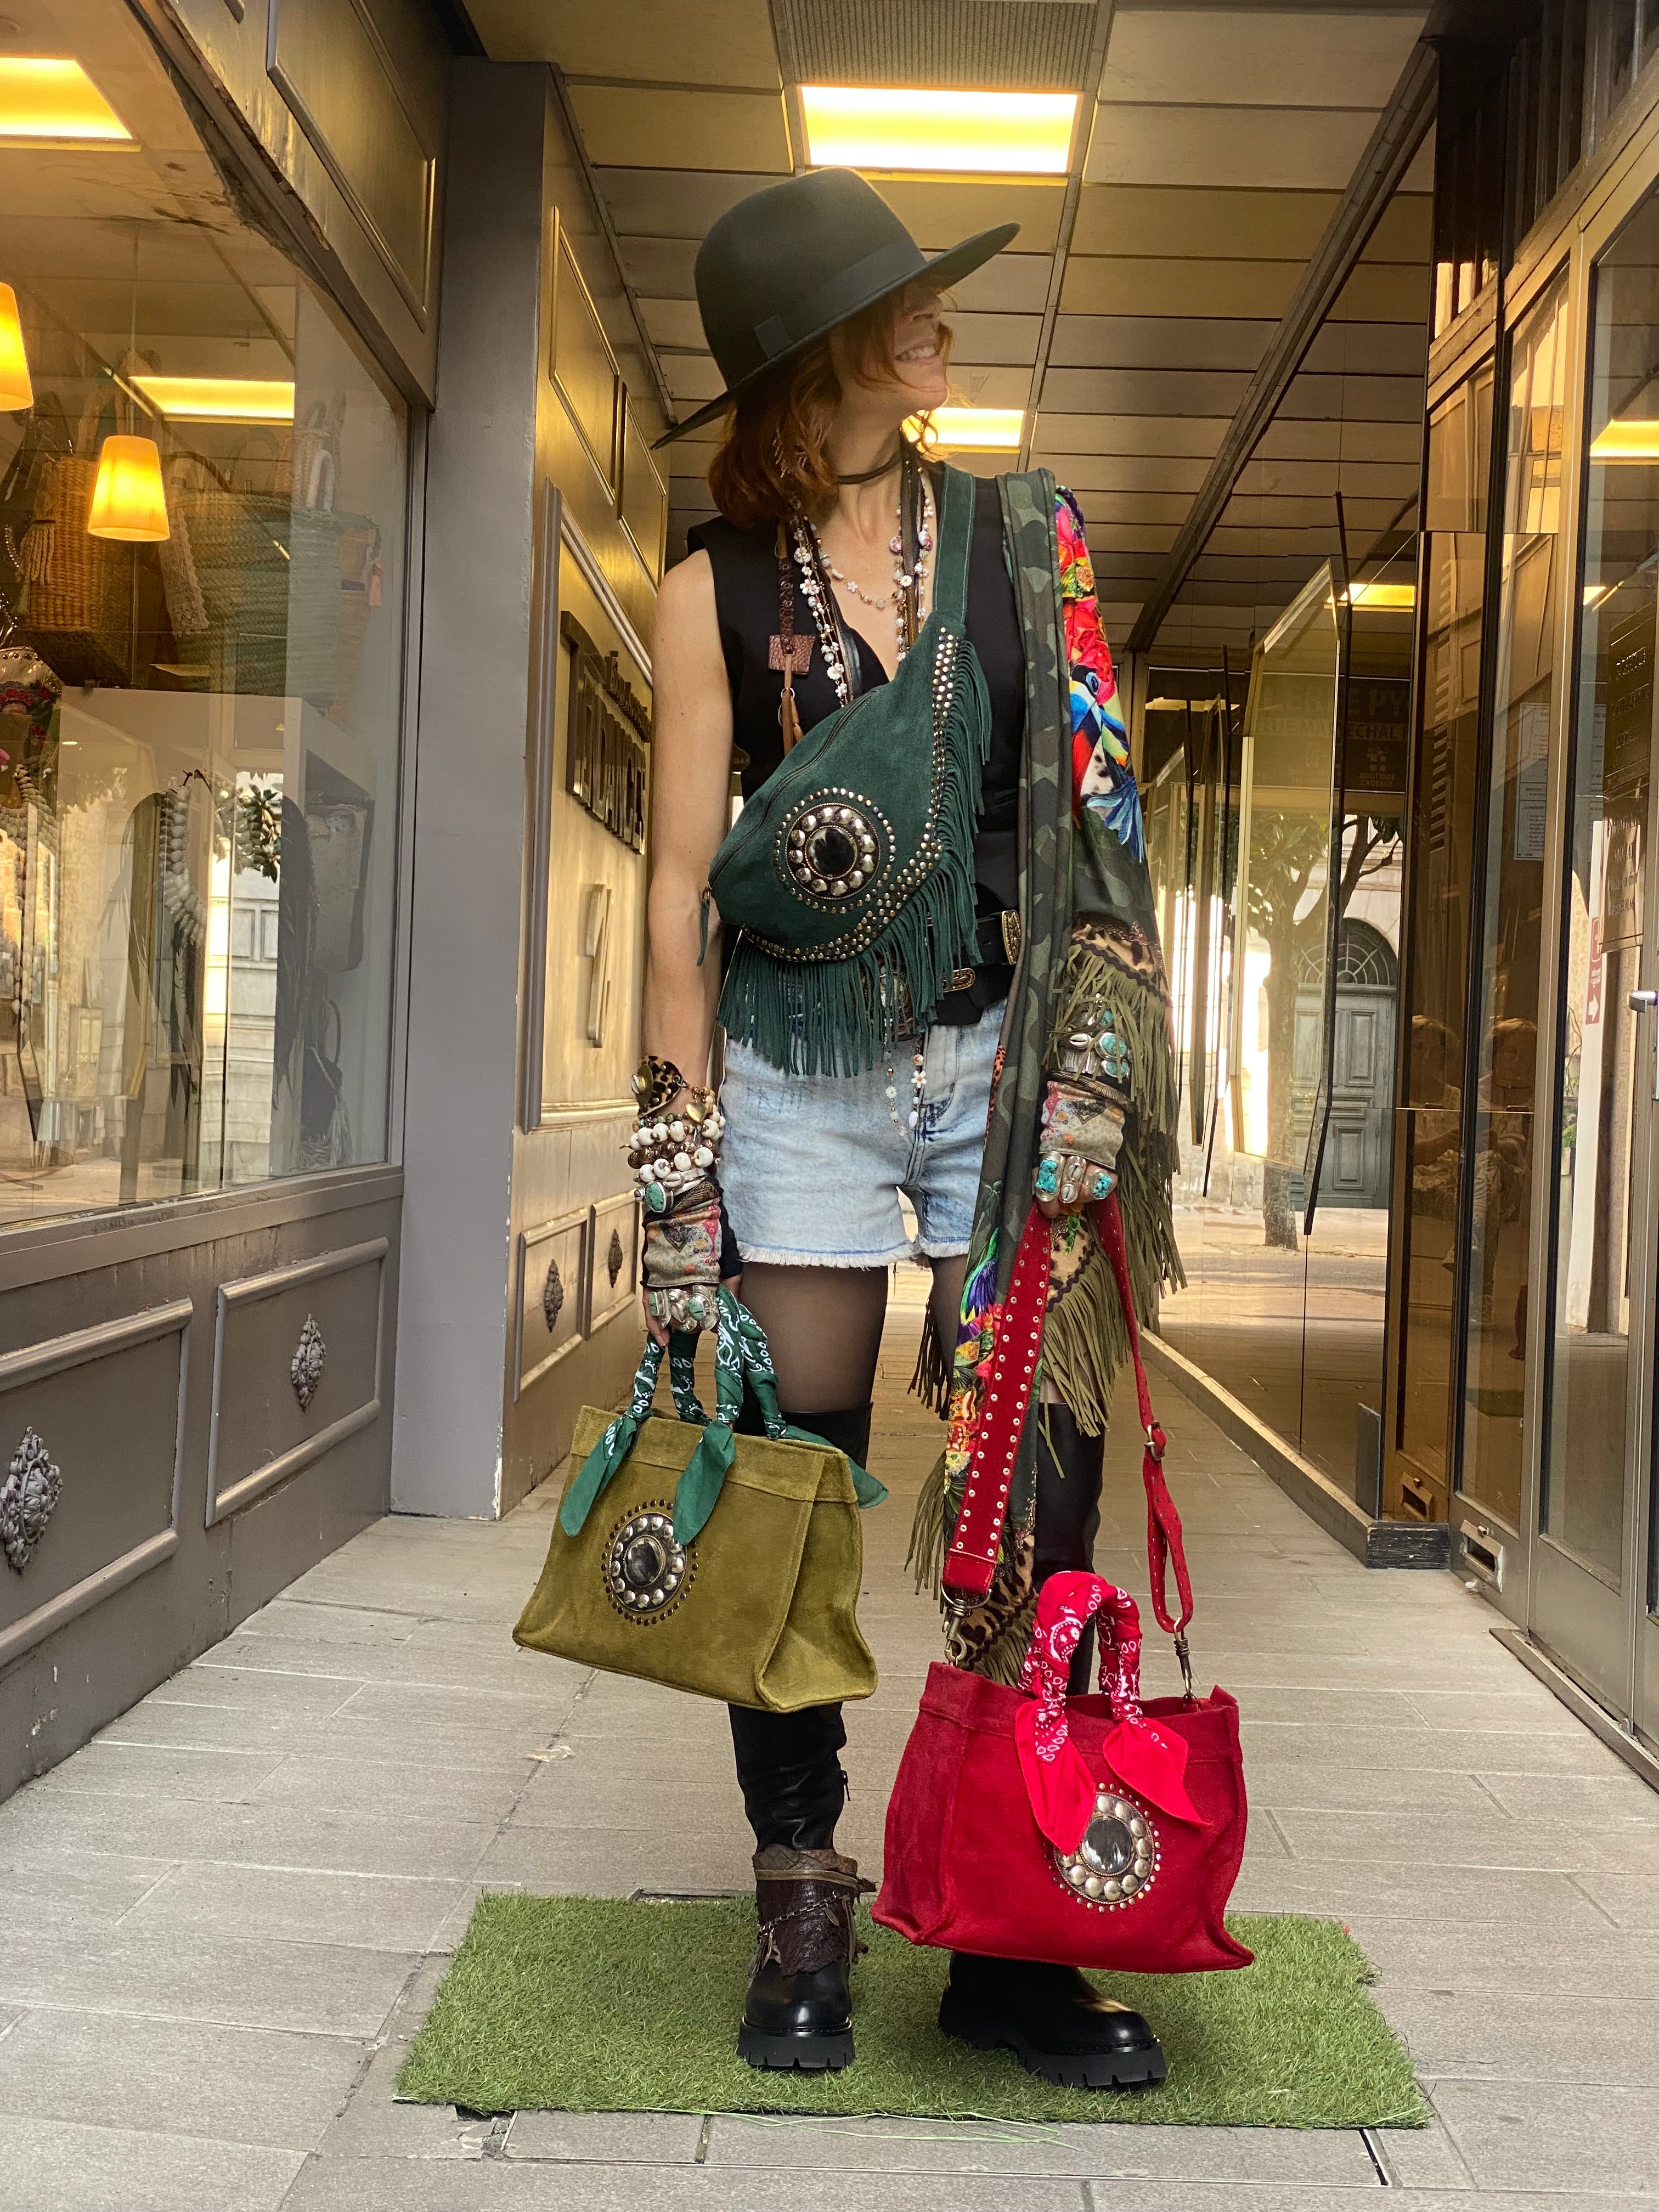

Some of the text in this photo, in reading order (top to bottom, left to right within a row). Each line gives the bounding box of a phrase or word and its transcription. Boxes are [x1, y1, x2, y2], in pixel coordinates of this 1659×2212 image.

[1369, 689, 1408, 717] PY
[1359, 772, 1396, 781] BOUTIQUE
[1361, 779, 1393, 787] CADEAUX
